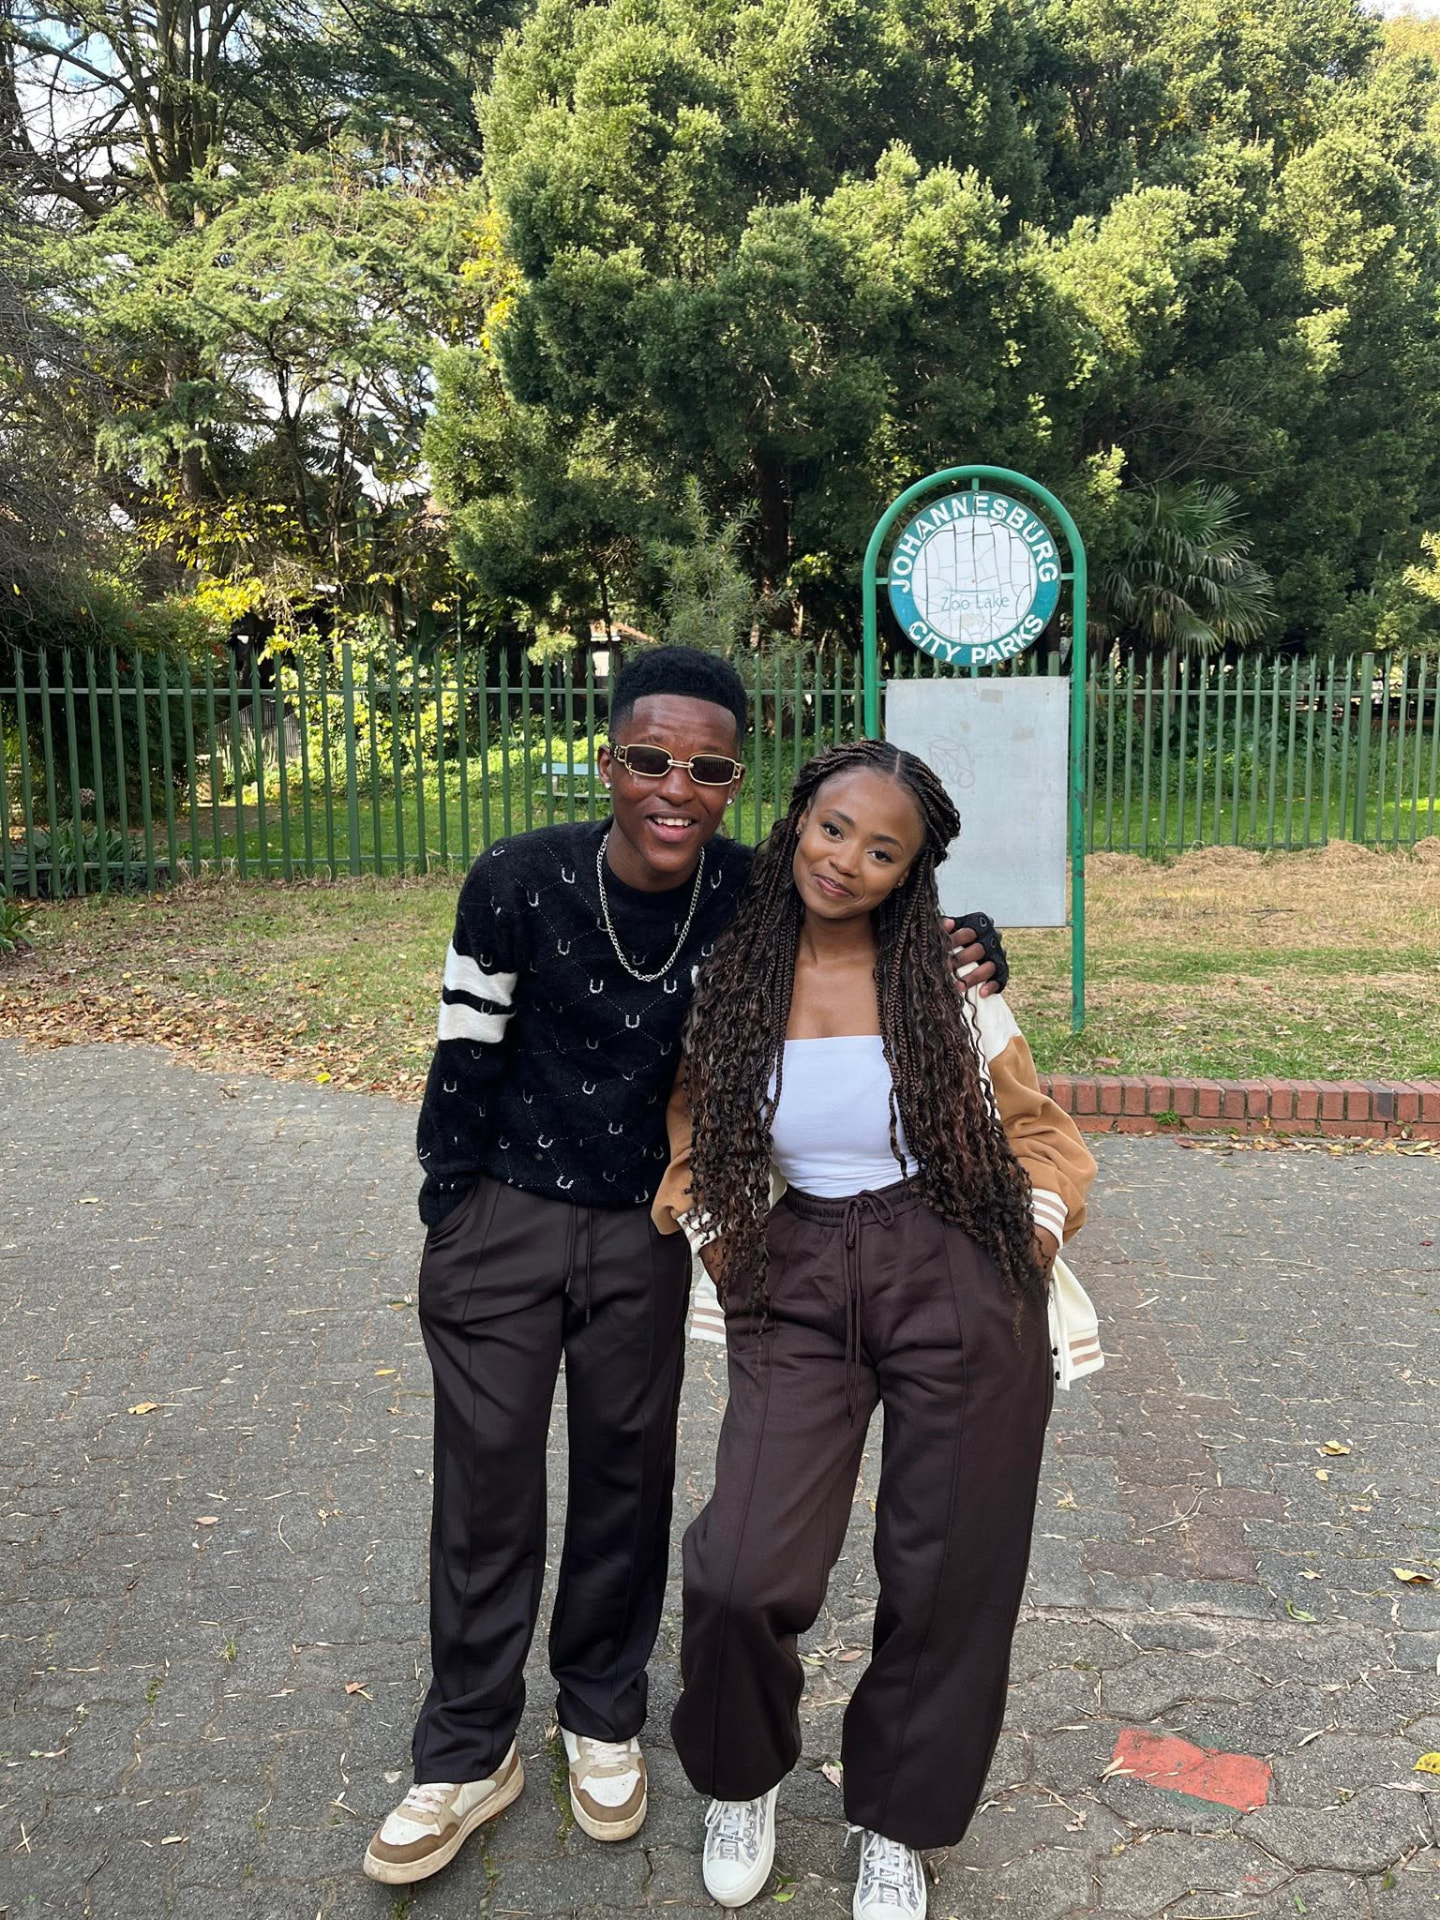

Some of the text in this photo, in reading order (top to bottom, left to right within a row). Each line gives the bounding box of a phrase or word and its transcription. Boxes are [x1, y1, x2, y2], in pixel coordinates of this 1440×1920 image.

[891, 495, 1058, 593] JOHANNESBURG
[941, 594, 1010, 612] Zoo Lake
[909, 614, 1044, 664] CITY PARKS
